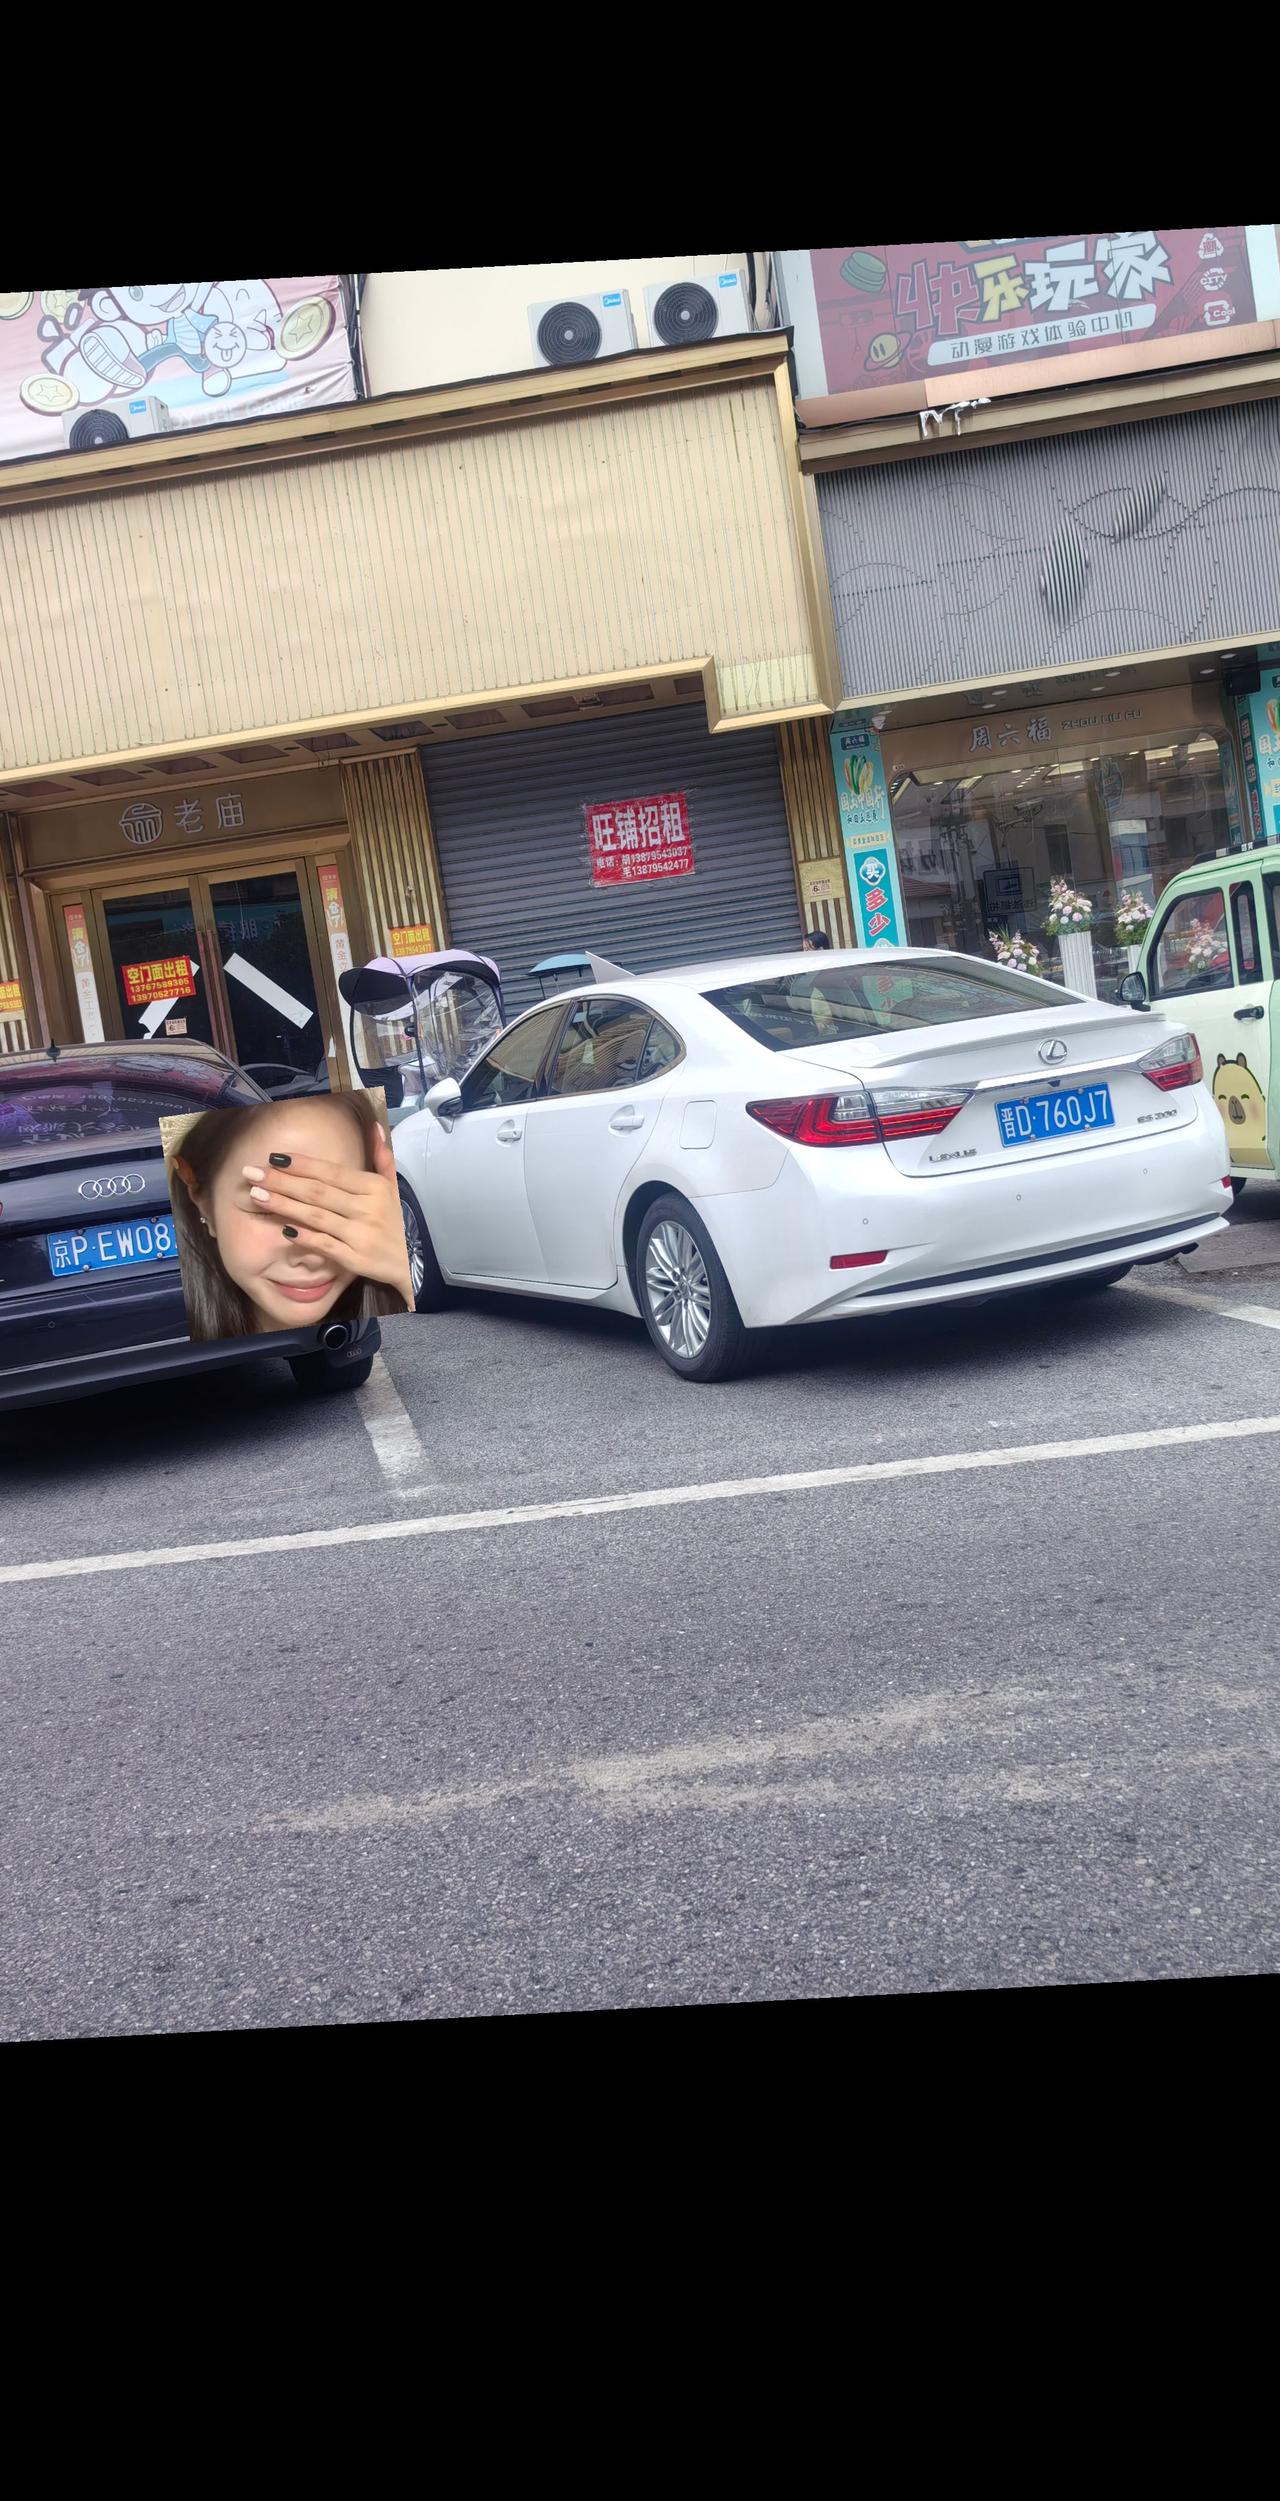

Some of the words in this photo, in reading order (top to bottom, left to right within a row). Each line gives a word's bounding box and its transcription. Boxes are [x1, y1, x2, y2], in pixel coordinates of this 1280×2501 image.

[896, 231, 1172, 336] 快乐玩家
[1200, 273, 1228, 286] CITY
[1212, 306, 1236, 318] Cool
[951, 311, 1134, 360] 动漫游戏体验中心
[969, 716, 1052, 752] 周六福
[1061, 716, 1098, 730] ZHOU
[174, 792, 245, 834] 老庙
[592, 802, 687, 852] 旺铺招租
[622, 858, 689, 878] 毛13879542477
[127, 959, 189, 985] 空门面出租
[131, 986, 192, 1003] 13970527716
[1000, 1089, 1107, 1139] 晋D·760J7
[53, 1222, 177, 1268] 京P·EW08
